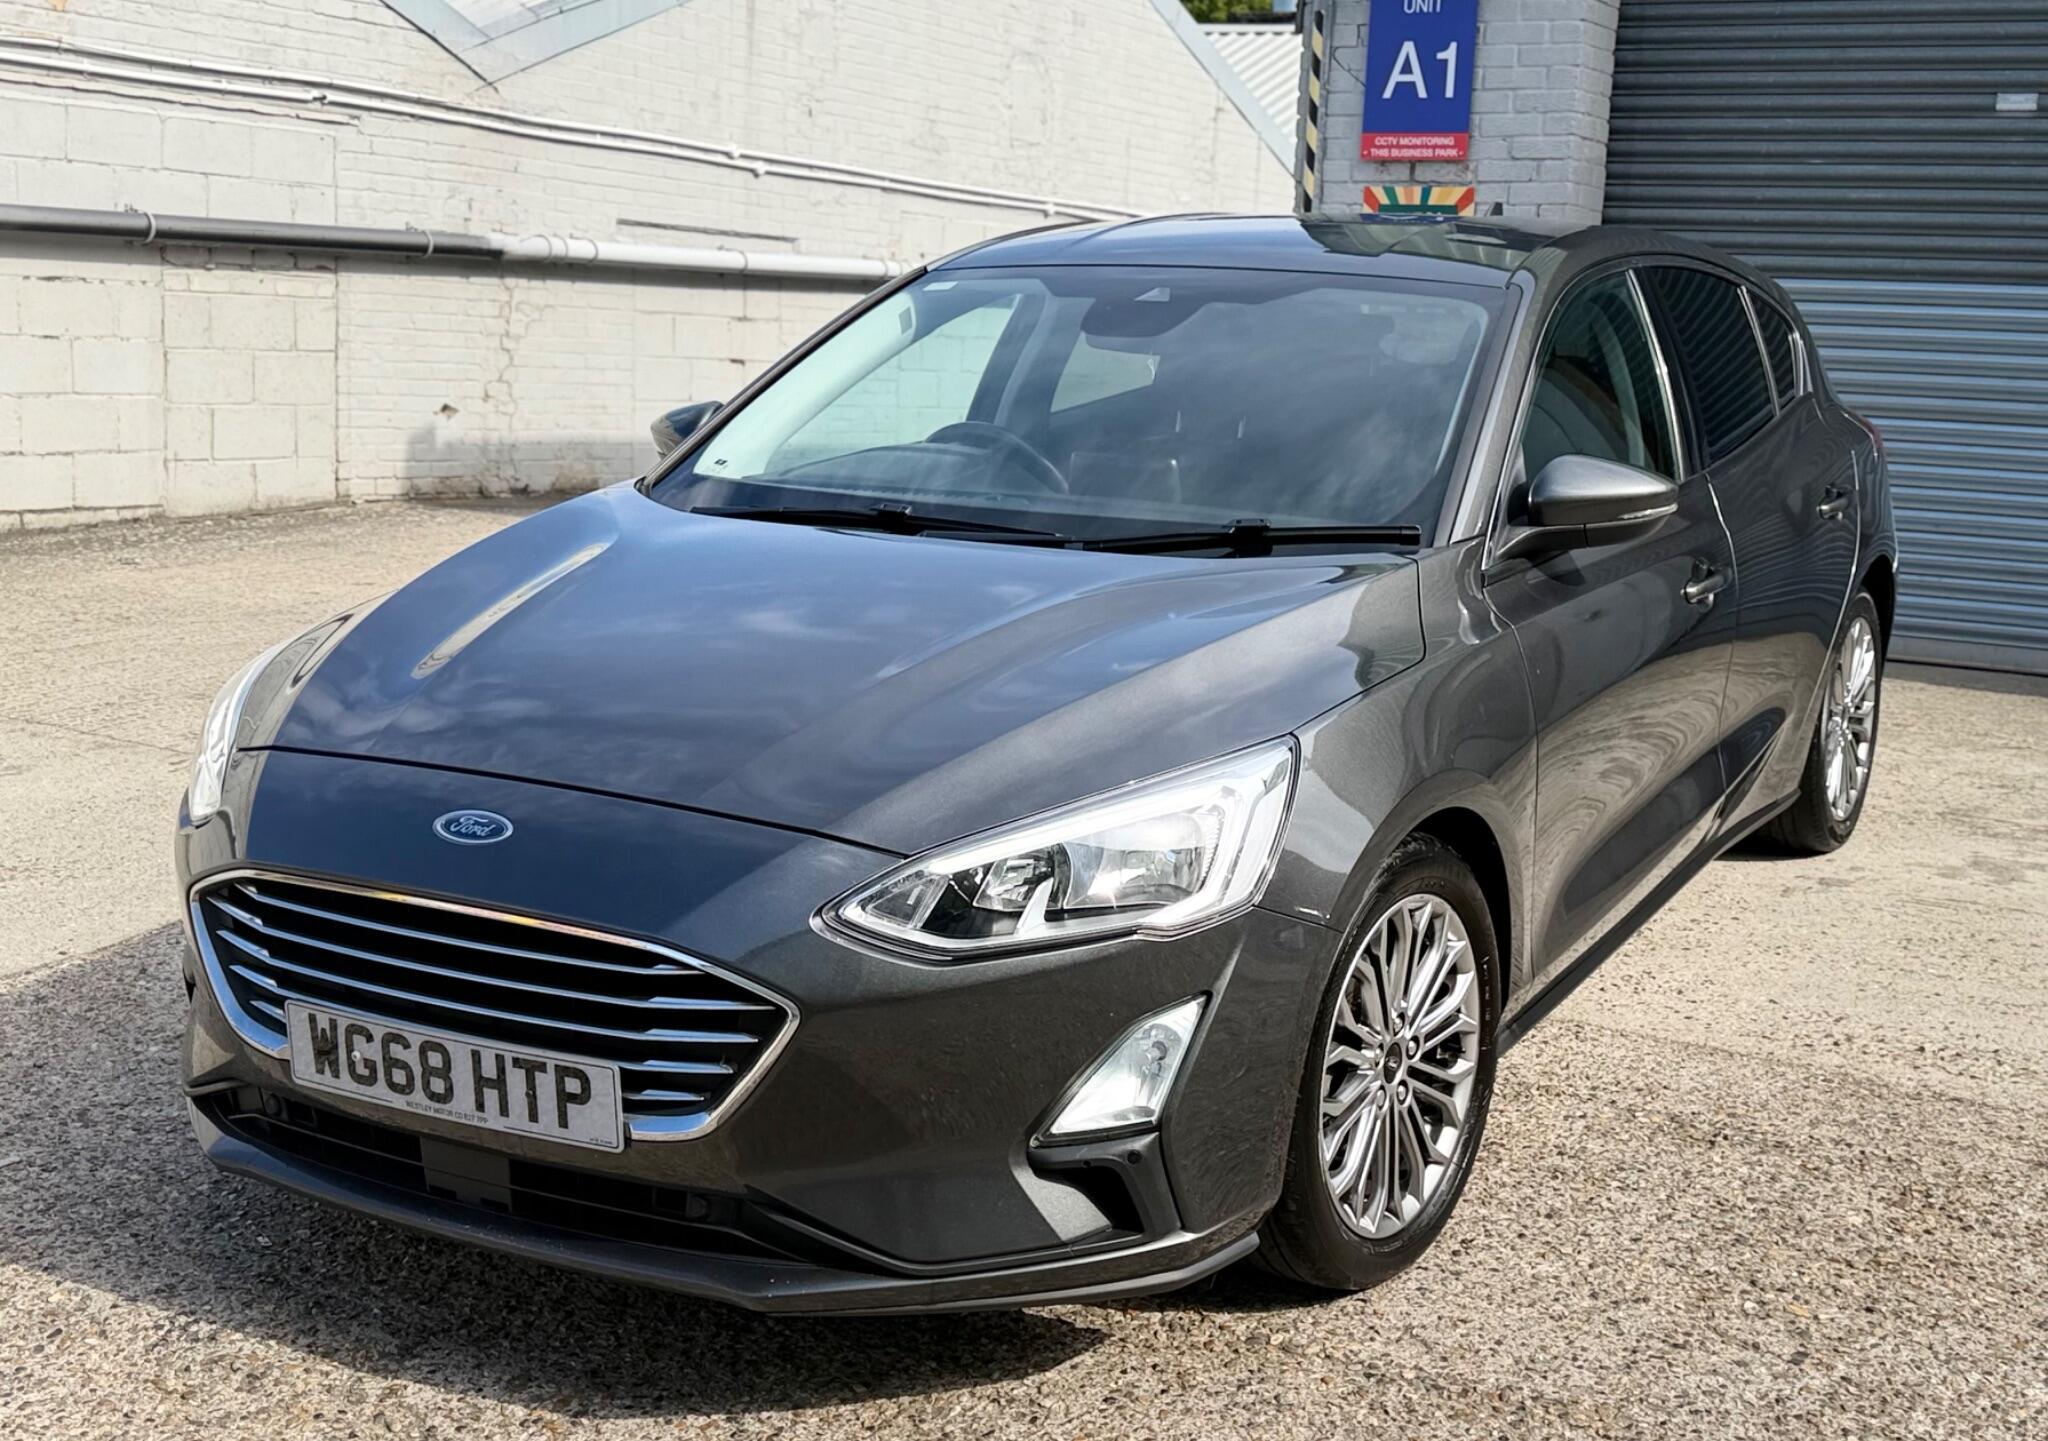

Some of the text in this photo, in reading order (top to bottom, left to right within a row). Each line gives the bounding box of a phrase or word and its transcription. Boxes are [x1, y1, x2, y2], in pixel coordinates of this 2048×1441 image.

[1382, 40, 1458, 98] A1
[1374, 136, 1455, 146] CCTV MONITORING
[1370, 148, 1458, 158] THIS BUSINESS PARK
[449, 815, 497, 837] Ford
[308, 1012, 592, 1130] WG68 HTP
